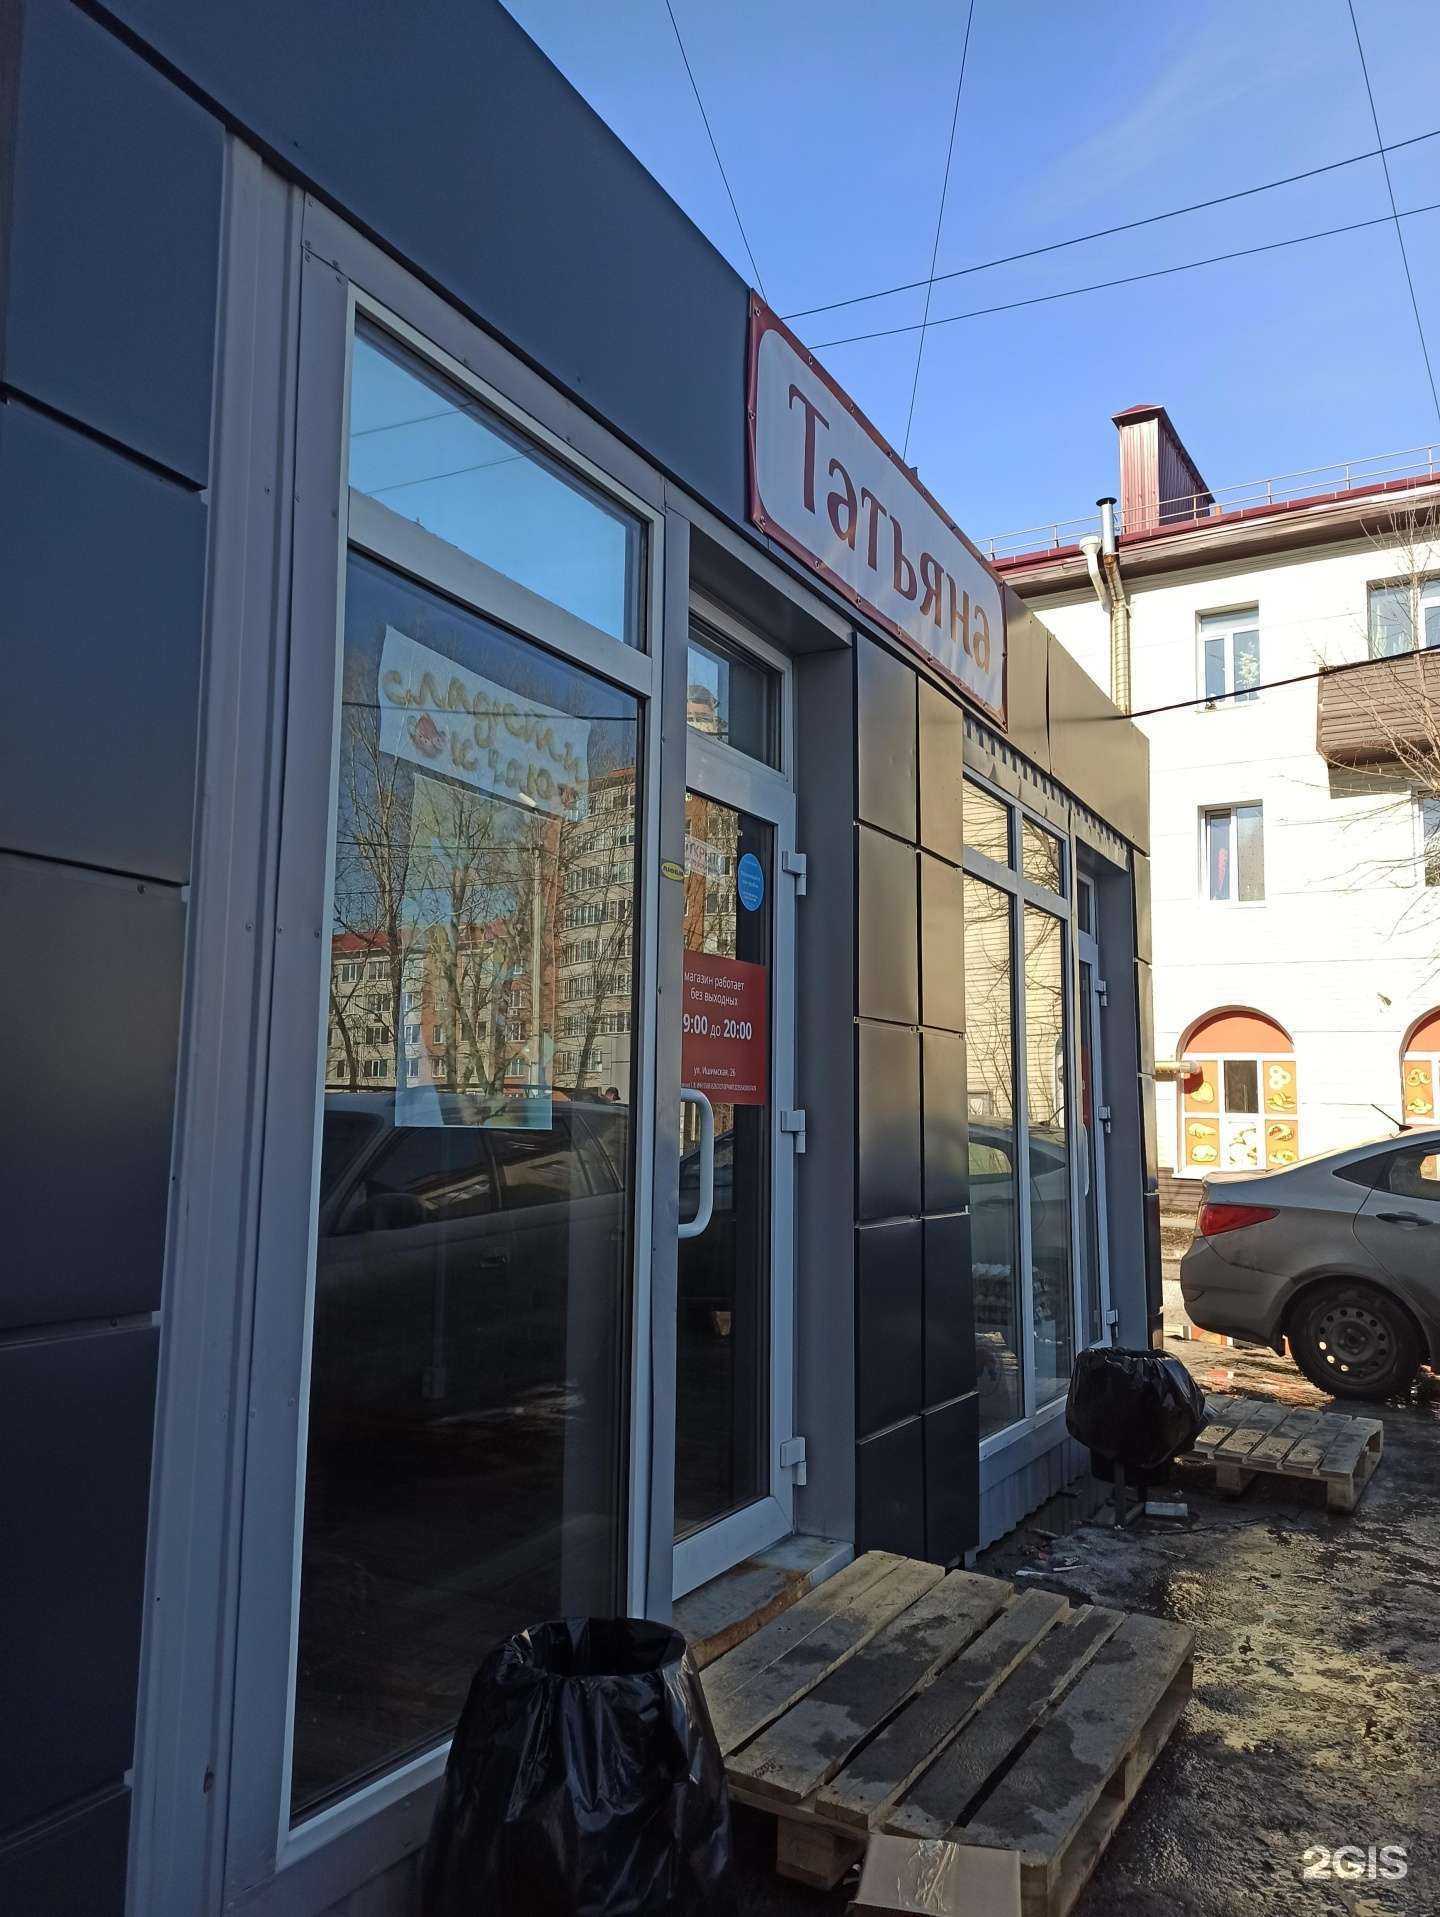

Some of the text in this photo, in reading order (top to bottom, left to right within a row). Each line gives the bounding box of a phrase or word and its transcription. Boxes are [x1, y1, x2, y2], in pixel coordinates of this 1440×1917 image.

[788, 383, 990, 675] Татьяна
[684, 970, 745, 992] магазин работает
[690, 987, 738, 1007] без выходных
[683, 1013, 752, 1041] 9:00 до 20:00
